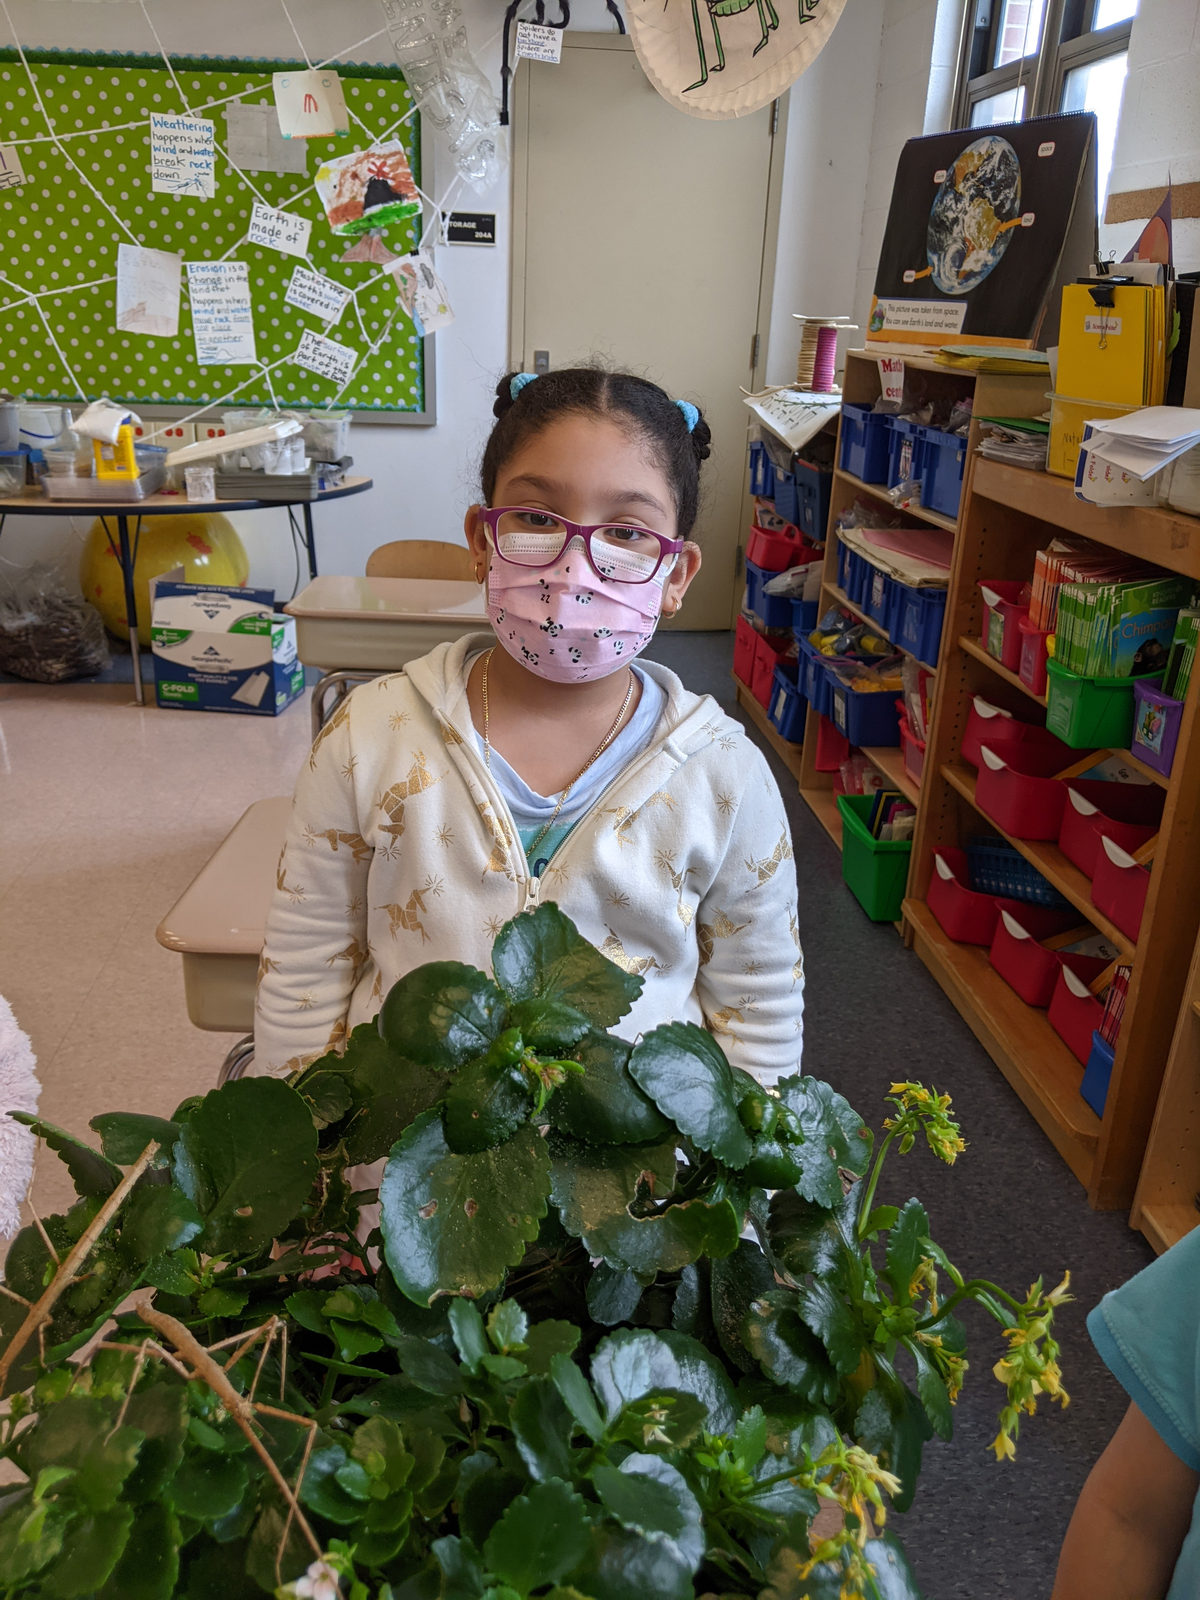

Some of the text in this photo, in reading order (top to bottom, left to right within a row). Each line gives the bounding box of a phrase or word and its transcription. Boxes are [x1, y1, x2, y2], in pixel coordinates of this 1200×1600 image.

[152, 117, 213, 139] Weathering
[153, 131, 215, 145] happens when
[179, 146, 192, 155] and
[154, 155, 212, 170] break rock
[153, 169, 180, 179] down
[255, 206, 304, 231] Earth is
[447, 220, 477, 229] TORAGE
[251, 222, 300, 244] made of
[251, 234, 279, 248] rock
[189, 264, 226, 274] Erosion
[296, 269, 315, 281] Most
[188, 275, 222, 286] change
[192, 297, 248, 306] happens when
[298, 291, 330, 309] covered
[933, 306, 943, 314] from
[934, 320, 943, 328] and
[304, 331, 322, 347] The
[312, 347, 338, 364] Earth
[881, 358, 902, 372] Math
[162, 683, 195, 693] C-FOLD
